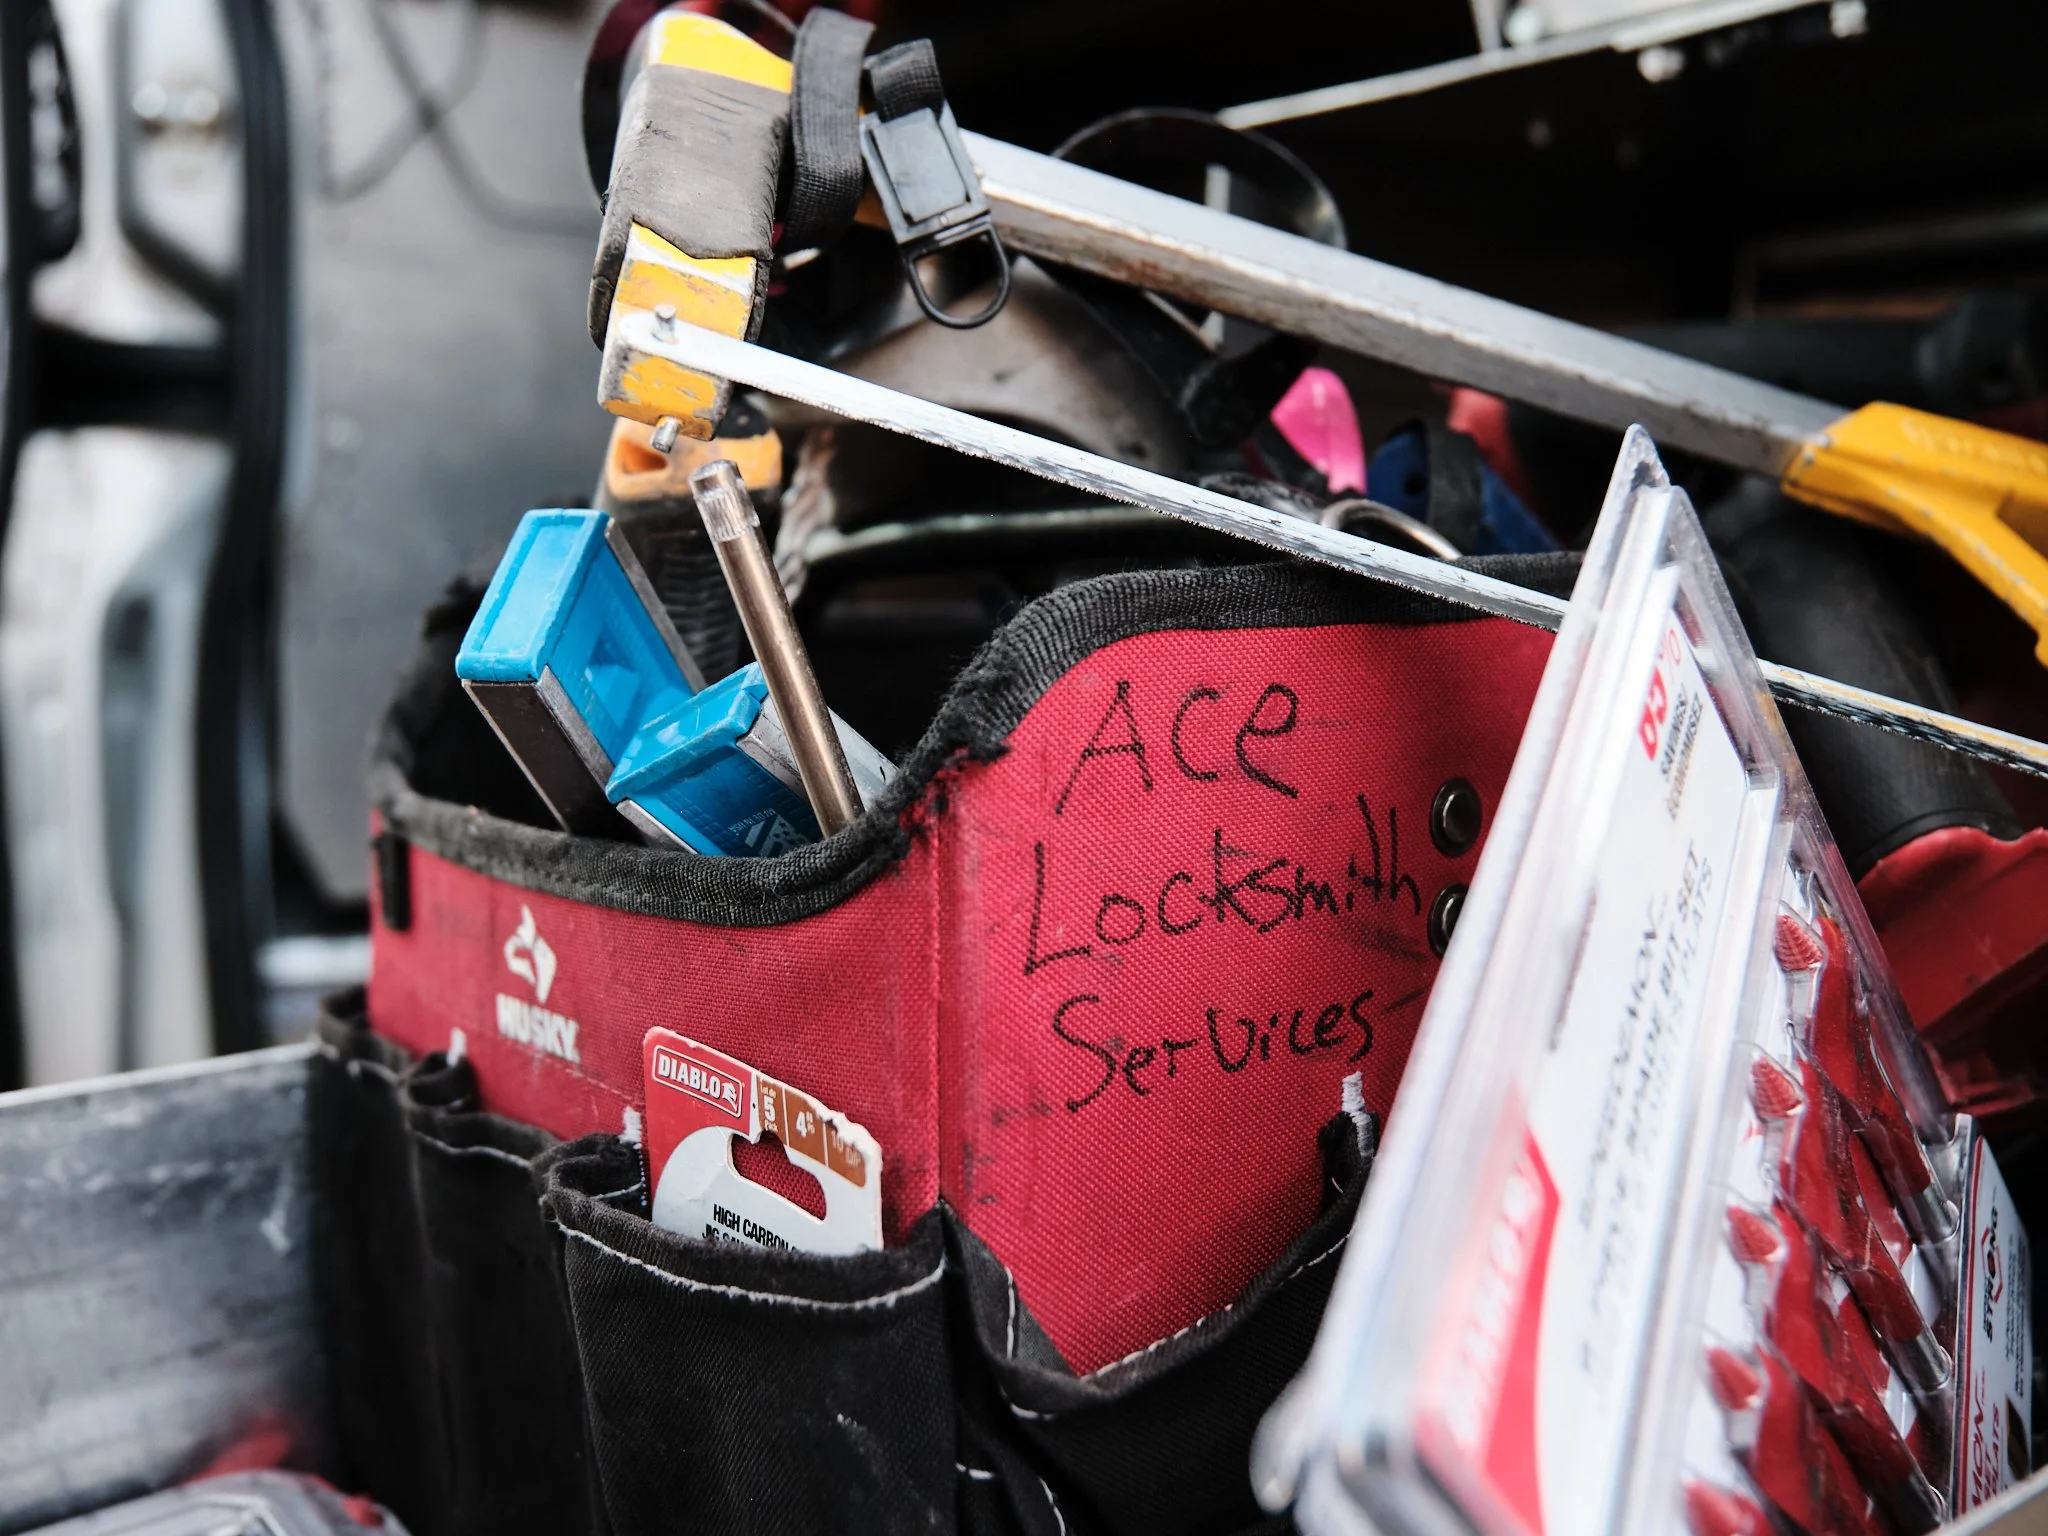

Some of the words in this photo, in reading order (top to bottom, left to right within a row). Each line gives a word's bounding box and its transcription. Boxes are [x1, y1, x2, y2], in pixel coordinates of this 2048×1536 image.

[1055, 679, 1299, 816] Ace
[1024, 793, 1422, 977] Locksmith
[1676, 839, 1698, 924] SET
[495, 992, 581, 1064] HUSKY
[1053, 989, 1374, 1114] Services
[657, 1053, 721, 1099] DIABLO
[763, 1096, 776, 1122] 5
[713, 1203, 741, 1233] HIGH
[743, 1218, 790, 1253] CARBON
